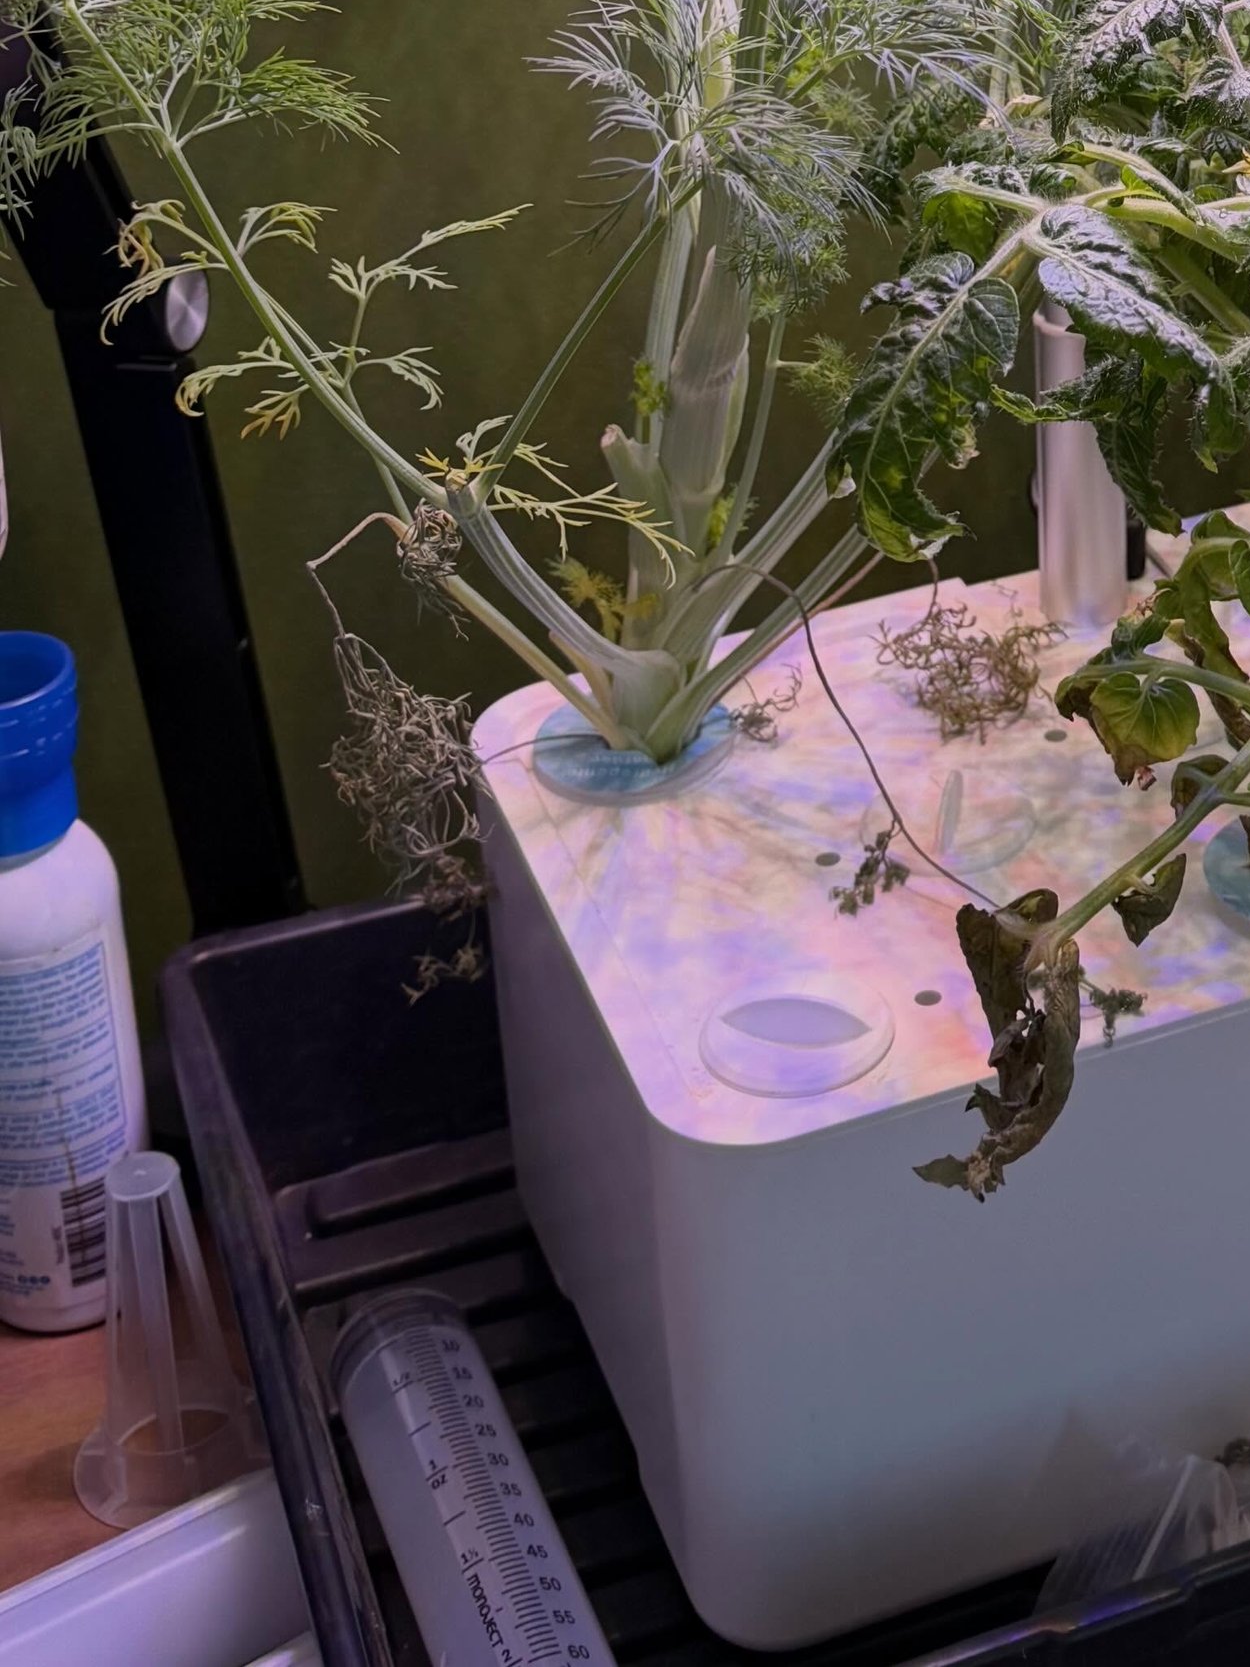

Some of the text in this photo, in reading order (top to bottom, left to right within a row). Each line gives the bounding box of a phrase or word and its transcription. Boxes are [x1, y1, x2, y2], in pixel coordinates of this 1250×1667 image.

[452, 1367, 472, 1380] 15
[462, 1393, 484, 1408] 20
[475, 1423, 497, 1438] 25
[487, 1452, 509, 1467] 30
[499, 1482, 522, 1497] 35
[513, 1512, 535, 1527] 40
[526, 1544, 549, 1559] 45
[539, 1576, 562, 1592] 50
[552, 1609, 576, 1625] 55
[501, 1648, 513, 1663] 2
[567, 1644, 590, 1660] 60
